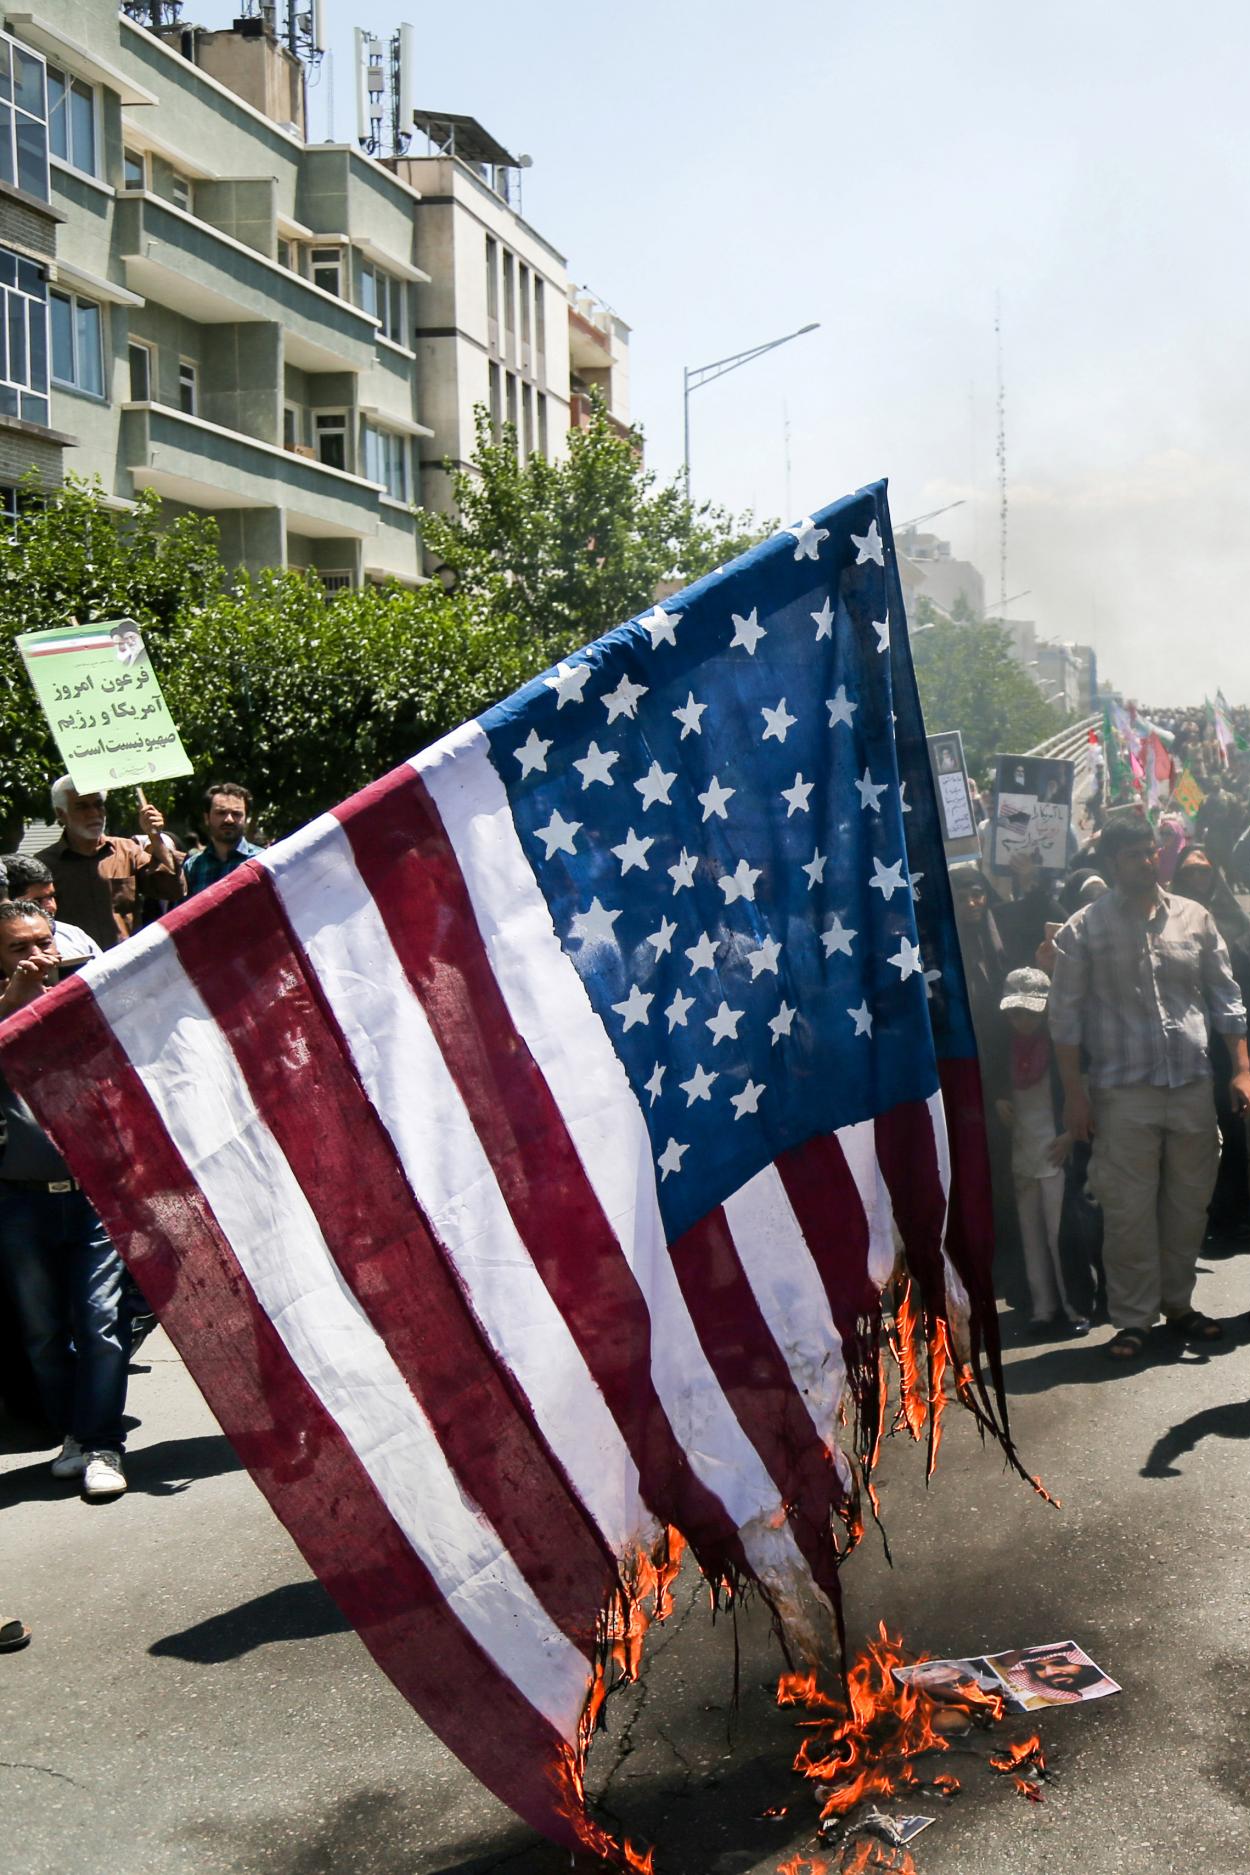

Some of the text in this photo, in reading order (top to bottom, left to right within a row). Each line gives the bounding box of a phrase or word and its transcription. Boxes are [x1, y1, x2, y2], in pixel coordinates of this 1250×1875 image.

[52, 666, 150, 702] فرعون امروز
[57, 694, 163, 732] آمریکا و رژیم
